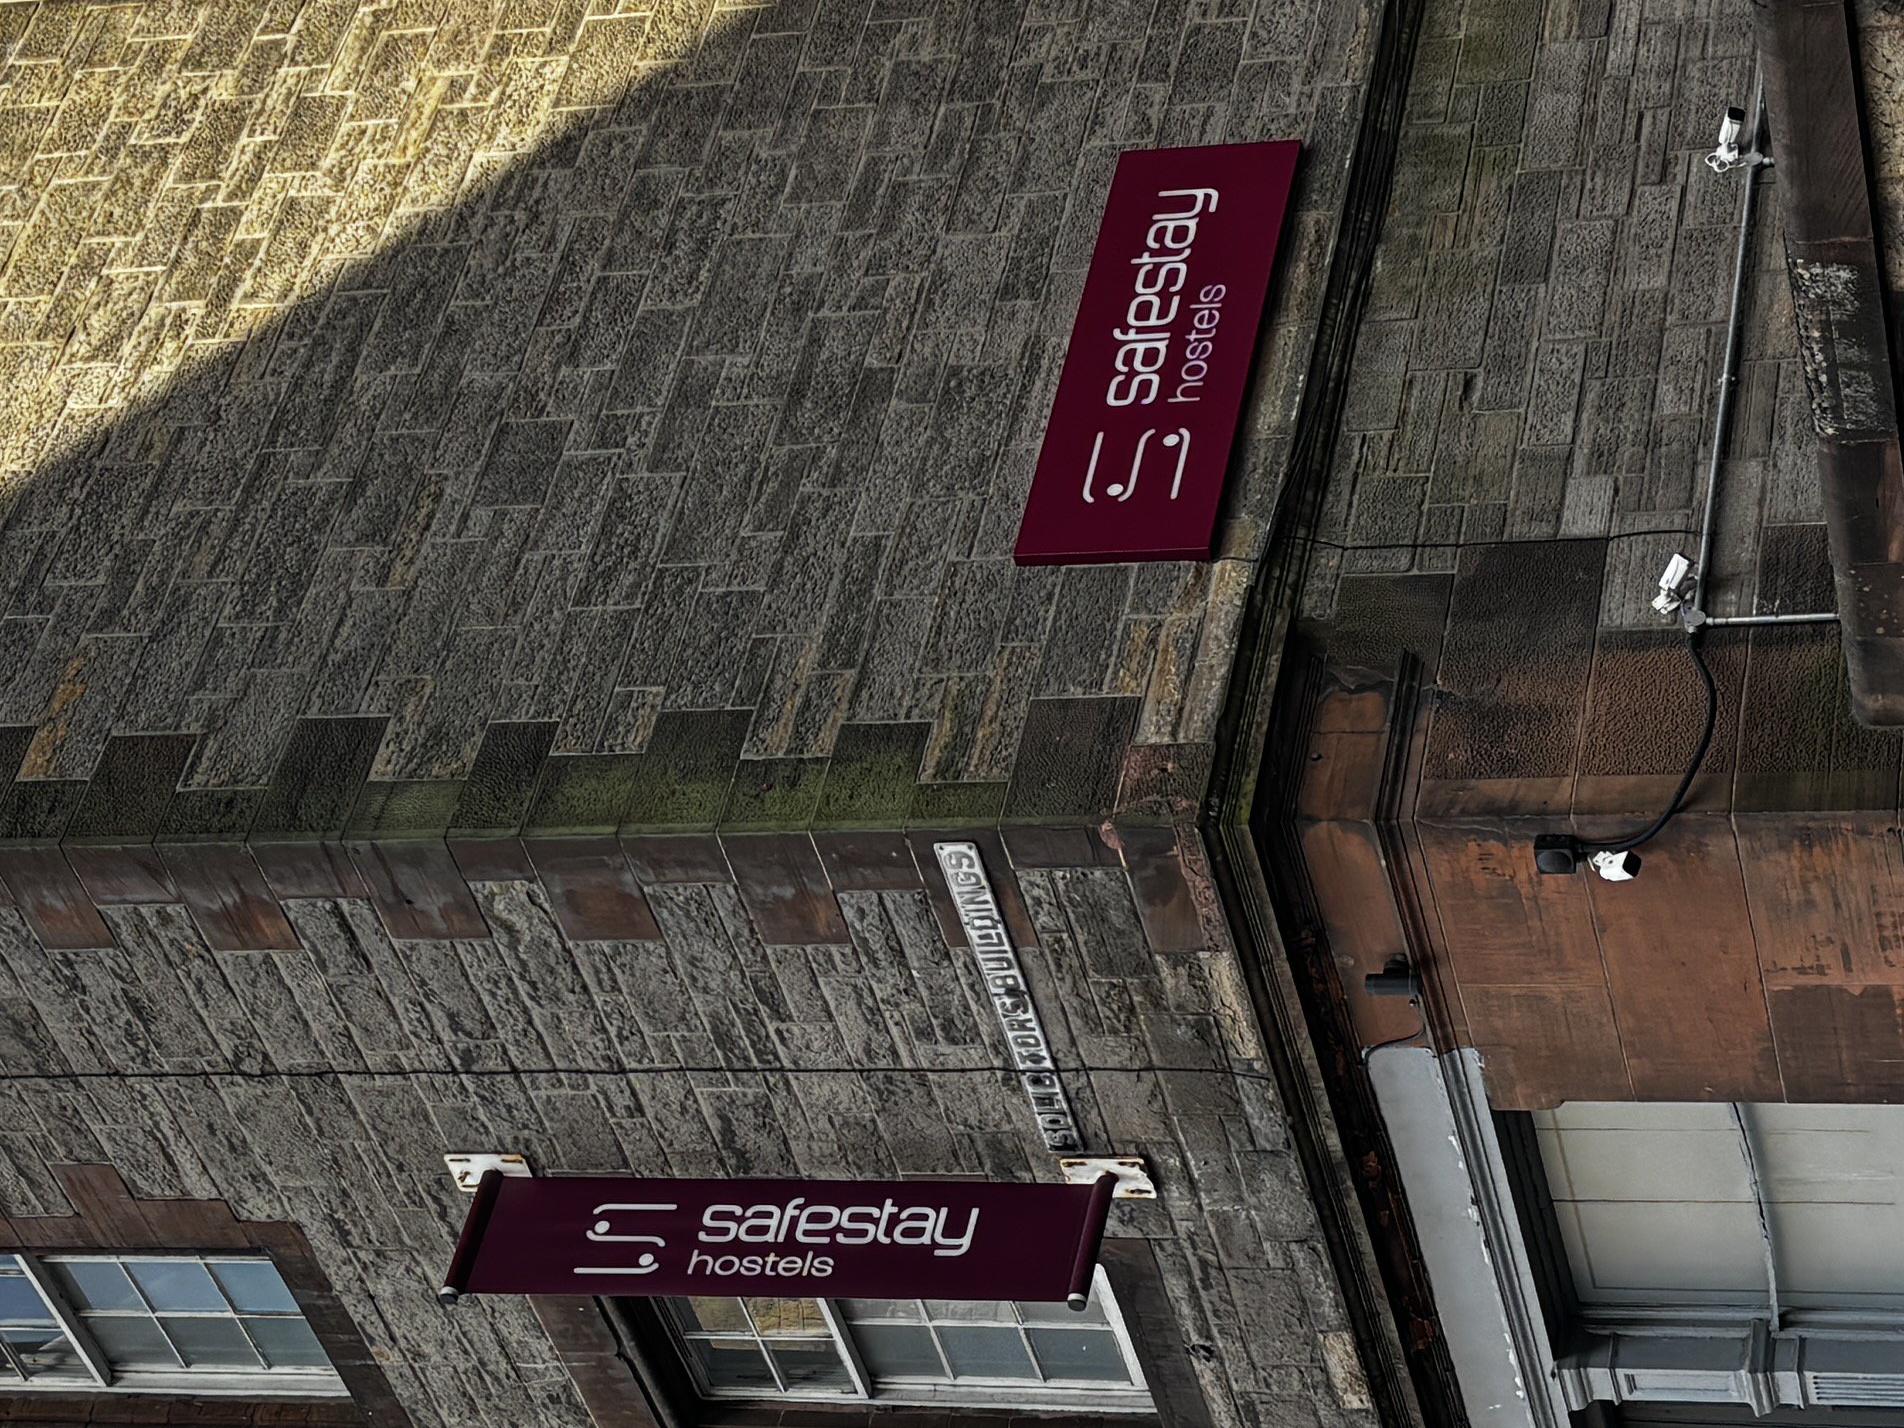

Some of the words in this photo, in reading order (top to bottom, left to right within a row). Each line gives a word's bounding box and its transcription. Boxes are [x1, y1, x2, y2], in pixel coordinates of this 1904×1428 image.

[1106, 189, 1219, 407] safestay
[1167, 284, 1226, 403] hostels
[943, 851, 1021, 989] BUILDINGS
[688, 1251, 834, 1278] hostels
[698, 1198, 980, 1256] safestay
